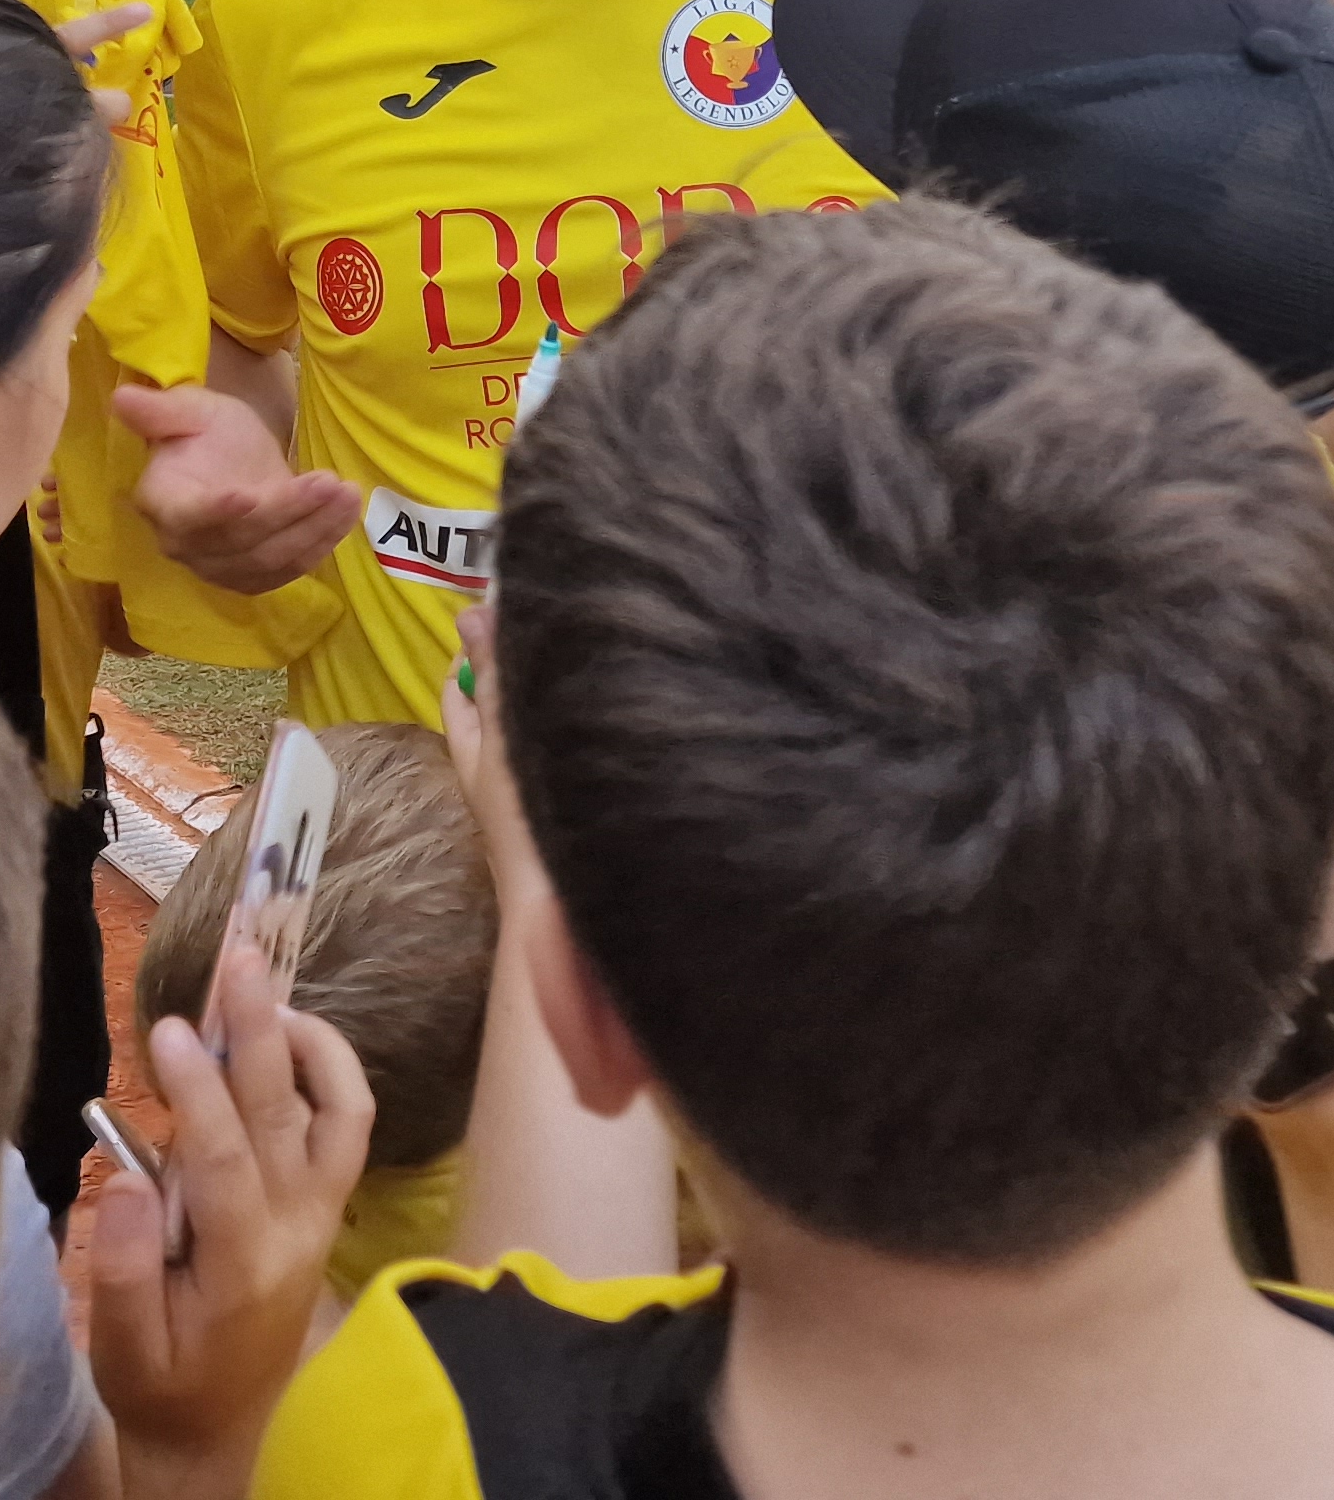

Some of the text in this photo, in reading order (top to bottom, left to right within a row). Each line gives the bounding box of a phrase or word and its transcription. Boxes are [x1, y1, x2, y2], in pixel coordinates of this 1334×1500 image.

[673, 71, 792, 122] LEGENDELO
[416, 182, 757, 354] DO
[464, 417, 516, 450] RO
[377, 511, 492, 568] AUT
